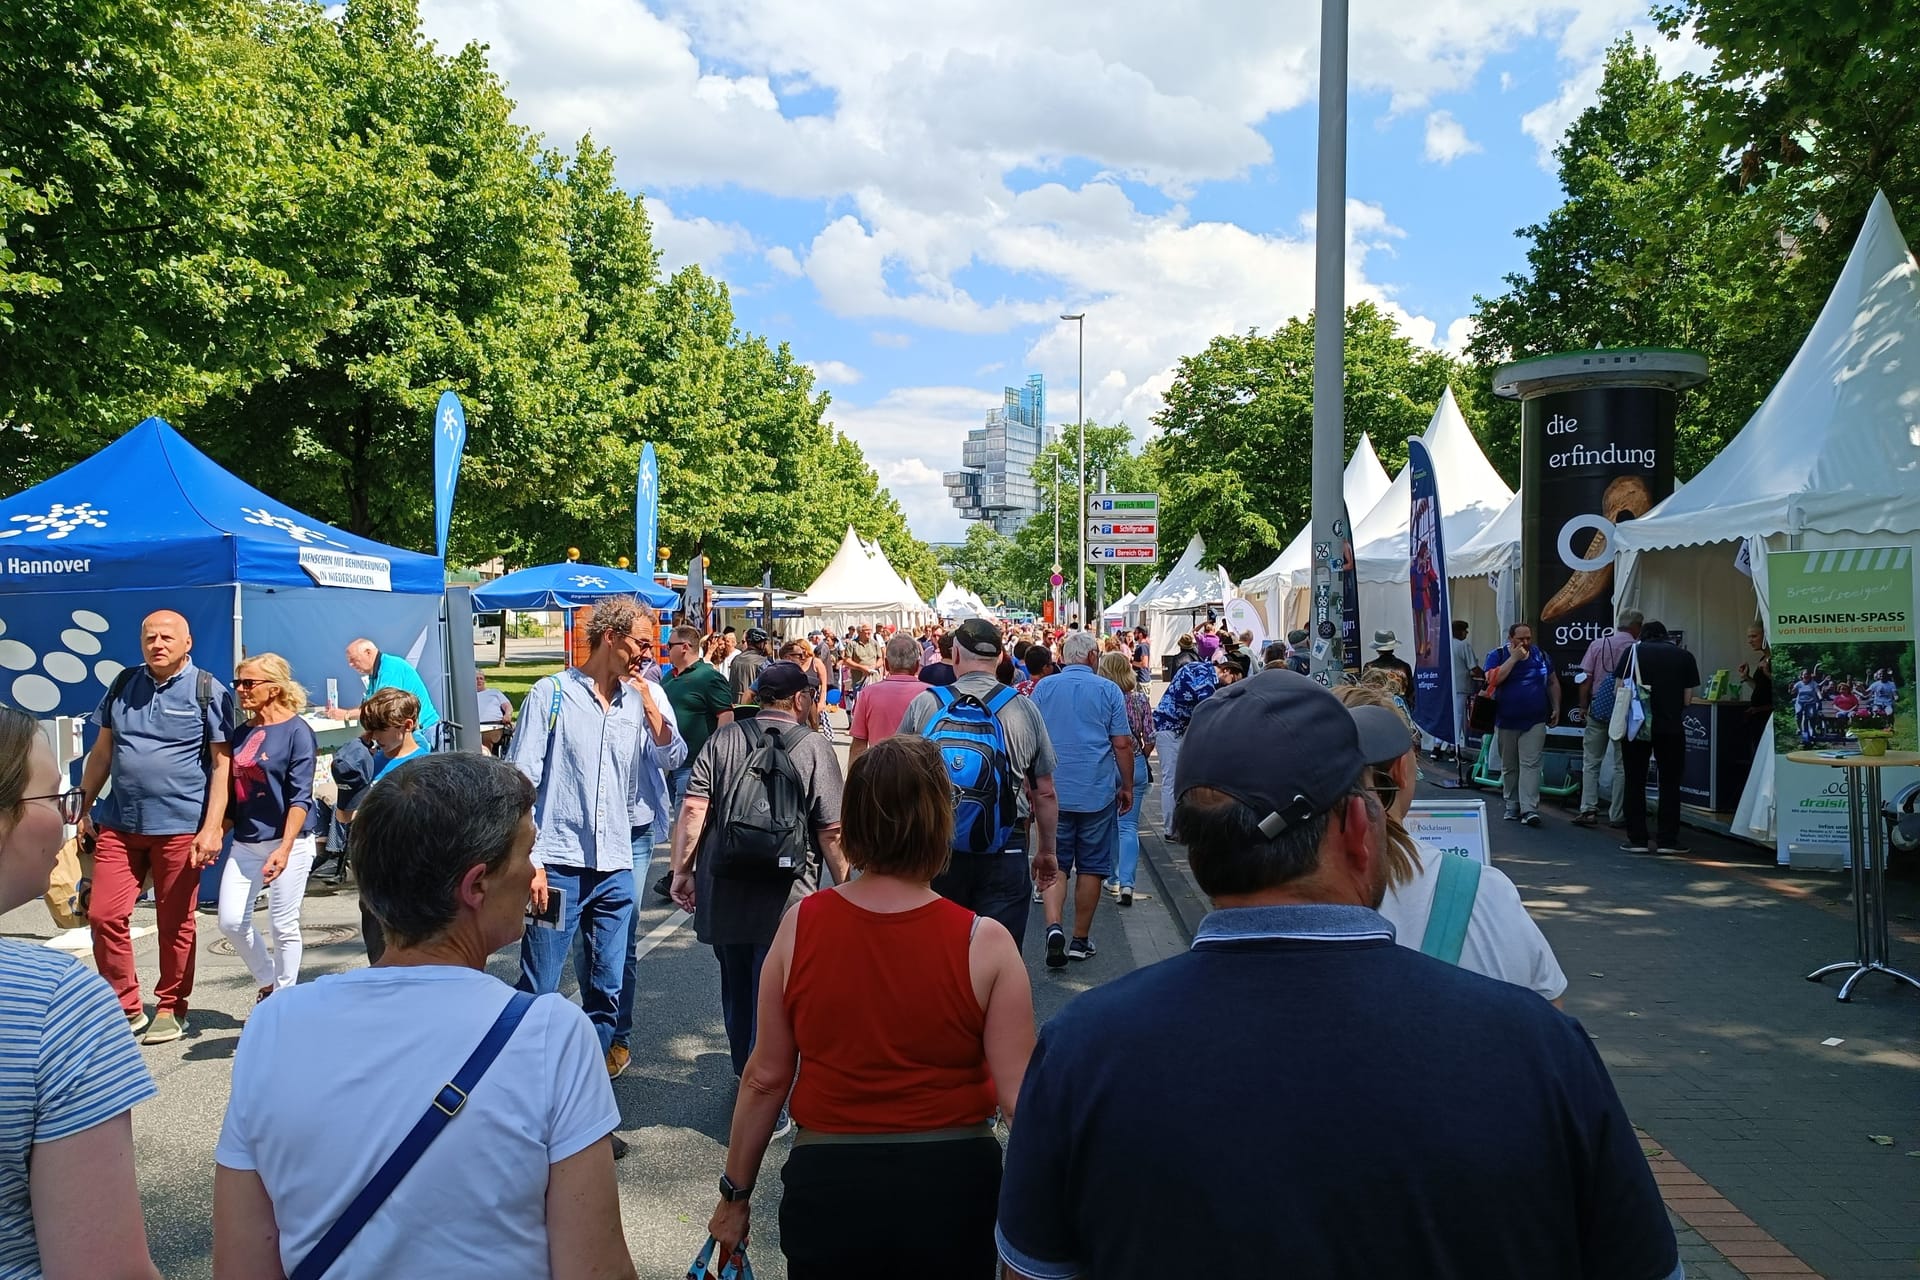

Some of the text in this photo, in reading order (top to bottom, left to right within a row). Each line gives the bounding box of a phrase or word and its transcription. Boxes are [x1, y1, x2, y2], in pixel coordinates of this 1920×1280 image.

[1546, 414, 1578, 435] die
[1549, 443, 1656, 468] erfindung
[1117, 548, 1137, 556] Bereich
[1138, 548, 1150, 557] Oper
[8, 557, 91, 574] Hannover
[301, 552, 389, 573] MENSCHEN MIT BEHINDERUNGEN
[328, 571, 374, 585] NIEDERSACHSEN
[1777, 611, 1905, 625] DRAISINEN-SPASS
[1798, 626, 1833, 635] Rinteln
[1835, 625, 1849, 634] bis
[1851, 625, 1865, 633] ins
[1868, 624, 1906, 633] Extertal
